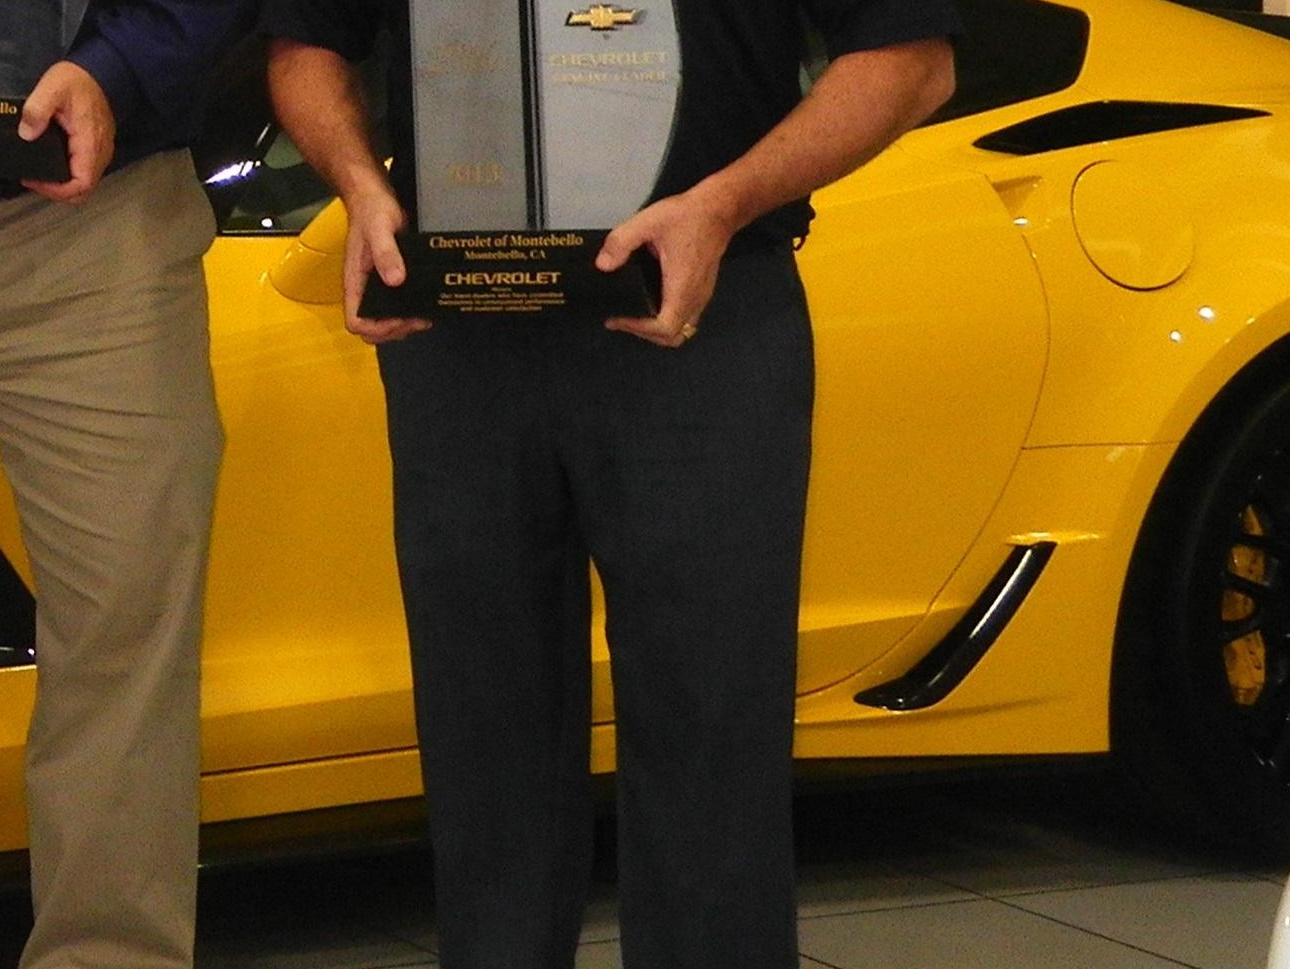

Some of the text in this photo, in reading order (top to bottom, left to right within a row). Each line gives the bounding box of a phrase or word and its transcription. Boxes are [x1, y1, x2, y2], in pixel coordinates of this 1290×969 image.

[548, 51, 669, 66] CHEVROLET
[429, 233, 584, 249] Chevrolet of Montebello
[529, 249, 547, 260] CA
[445, 271, 562, 285] CHEVROLET
